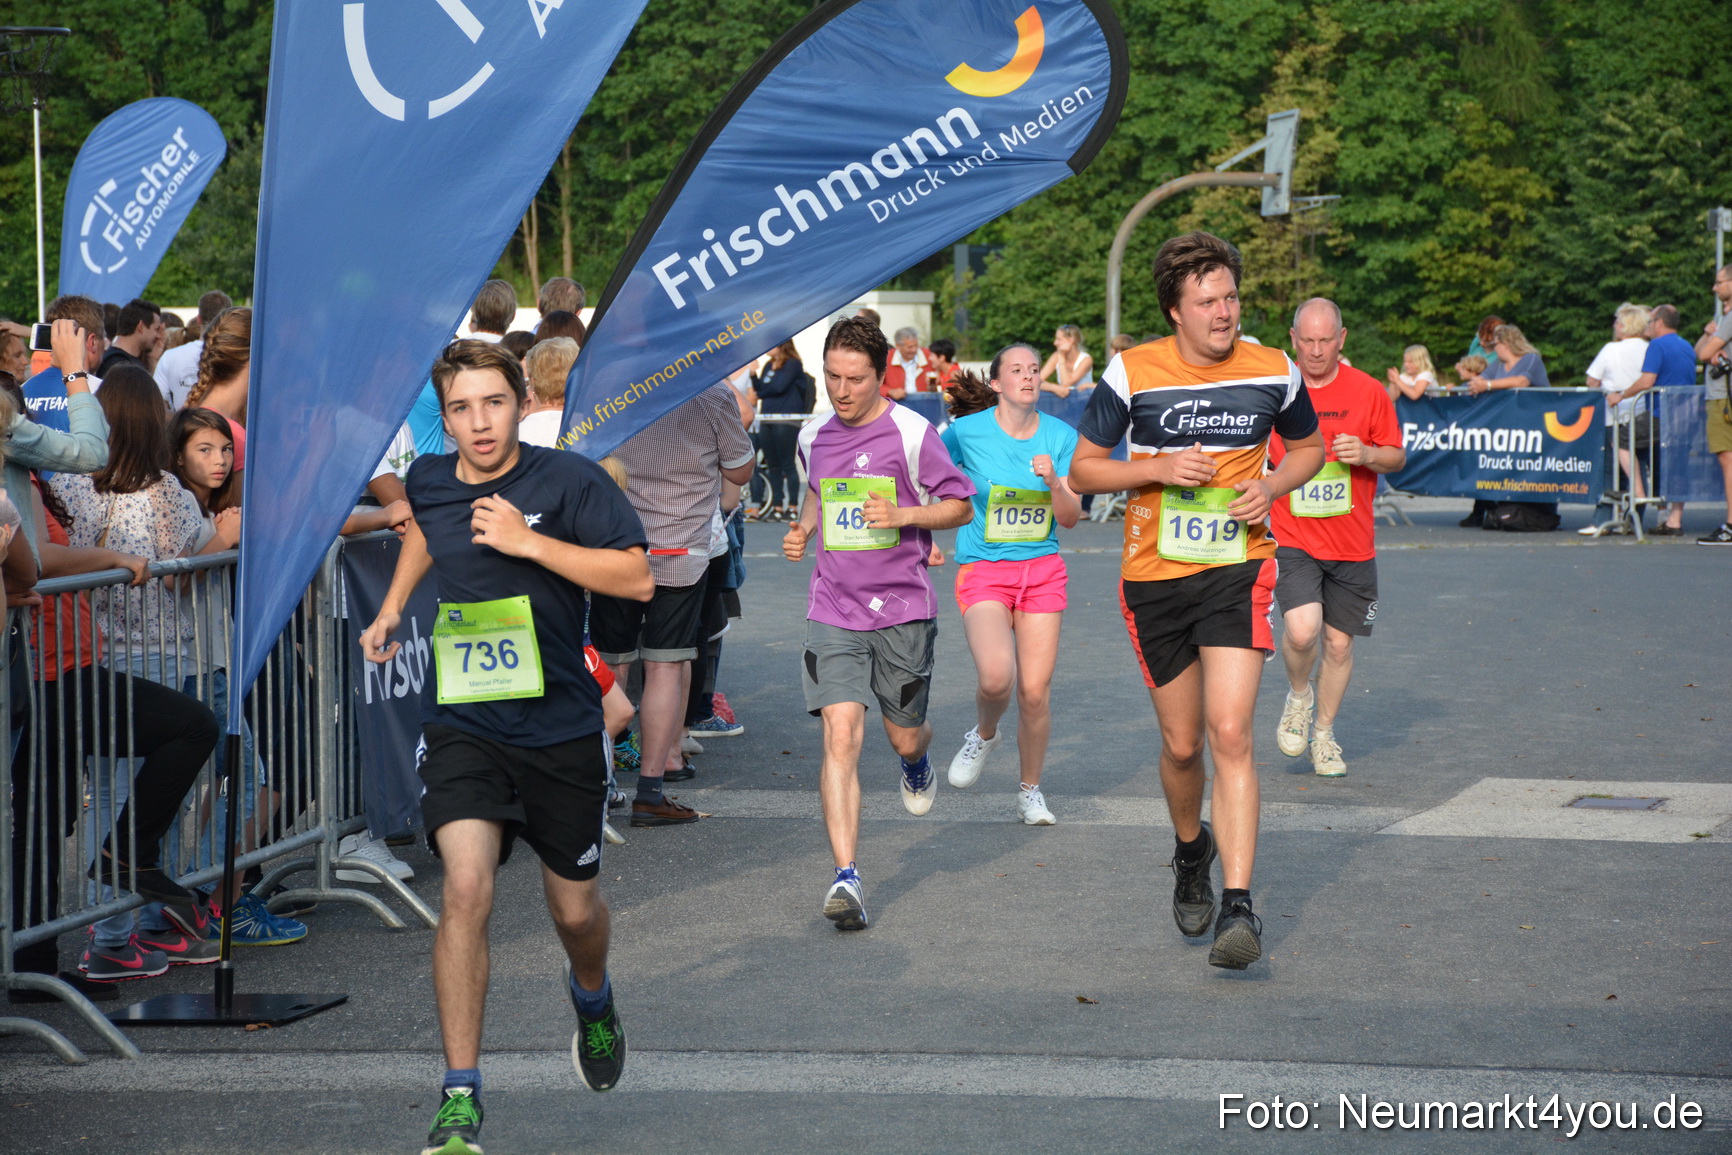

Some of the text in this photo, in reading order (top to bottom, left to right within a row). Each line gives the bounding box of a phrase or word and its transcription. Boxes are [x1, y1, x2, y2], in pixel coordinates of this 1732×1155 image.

[866, 86, 1093, 223] Druck und Medien
[102, 126, 188, 253] Fischer
[135, 150, 199, 251] AUTOMOBILE
[652, 107, 981, 310] Frischmann
[1178, 411, 1258, 429] Fischer
[1186, 428, 1253, 436] AUTOMOBILE
[1402, 421, 1542, 453] Frischmann
[1478, 453, 1592, 473] Druck und Medien
[1298, 483, 1345, 501] 1482
[1476, 478, 1589, 494] www.frischmann-net.de
[836, 507, 876, 530] 46
[994, 507, 1046, 525] 1058
[1170, 515, 1239, 542] 1619
[454, 639, 519, 673] 736
